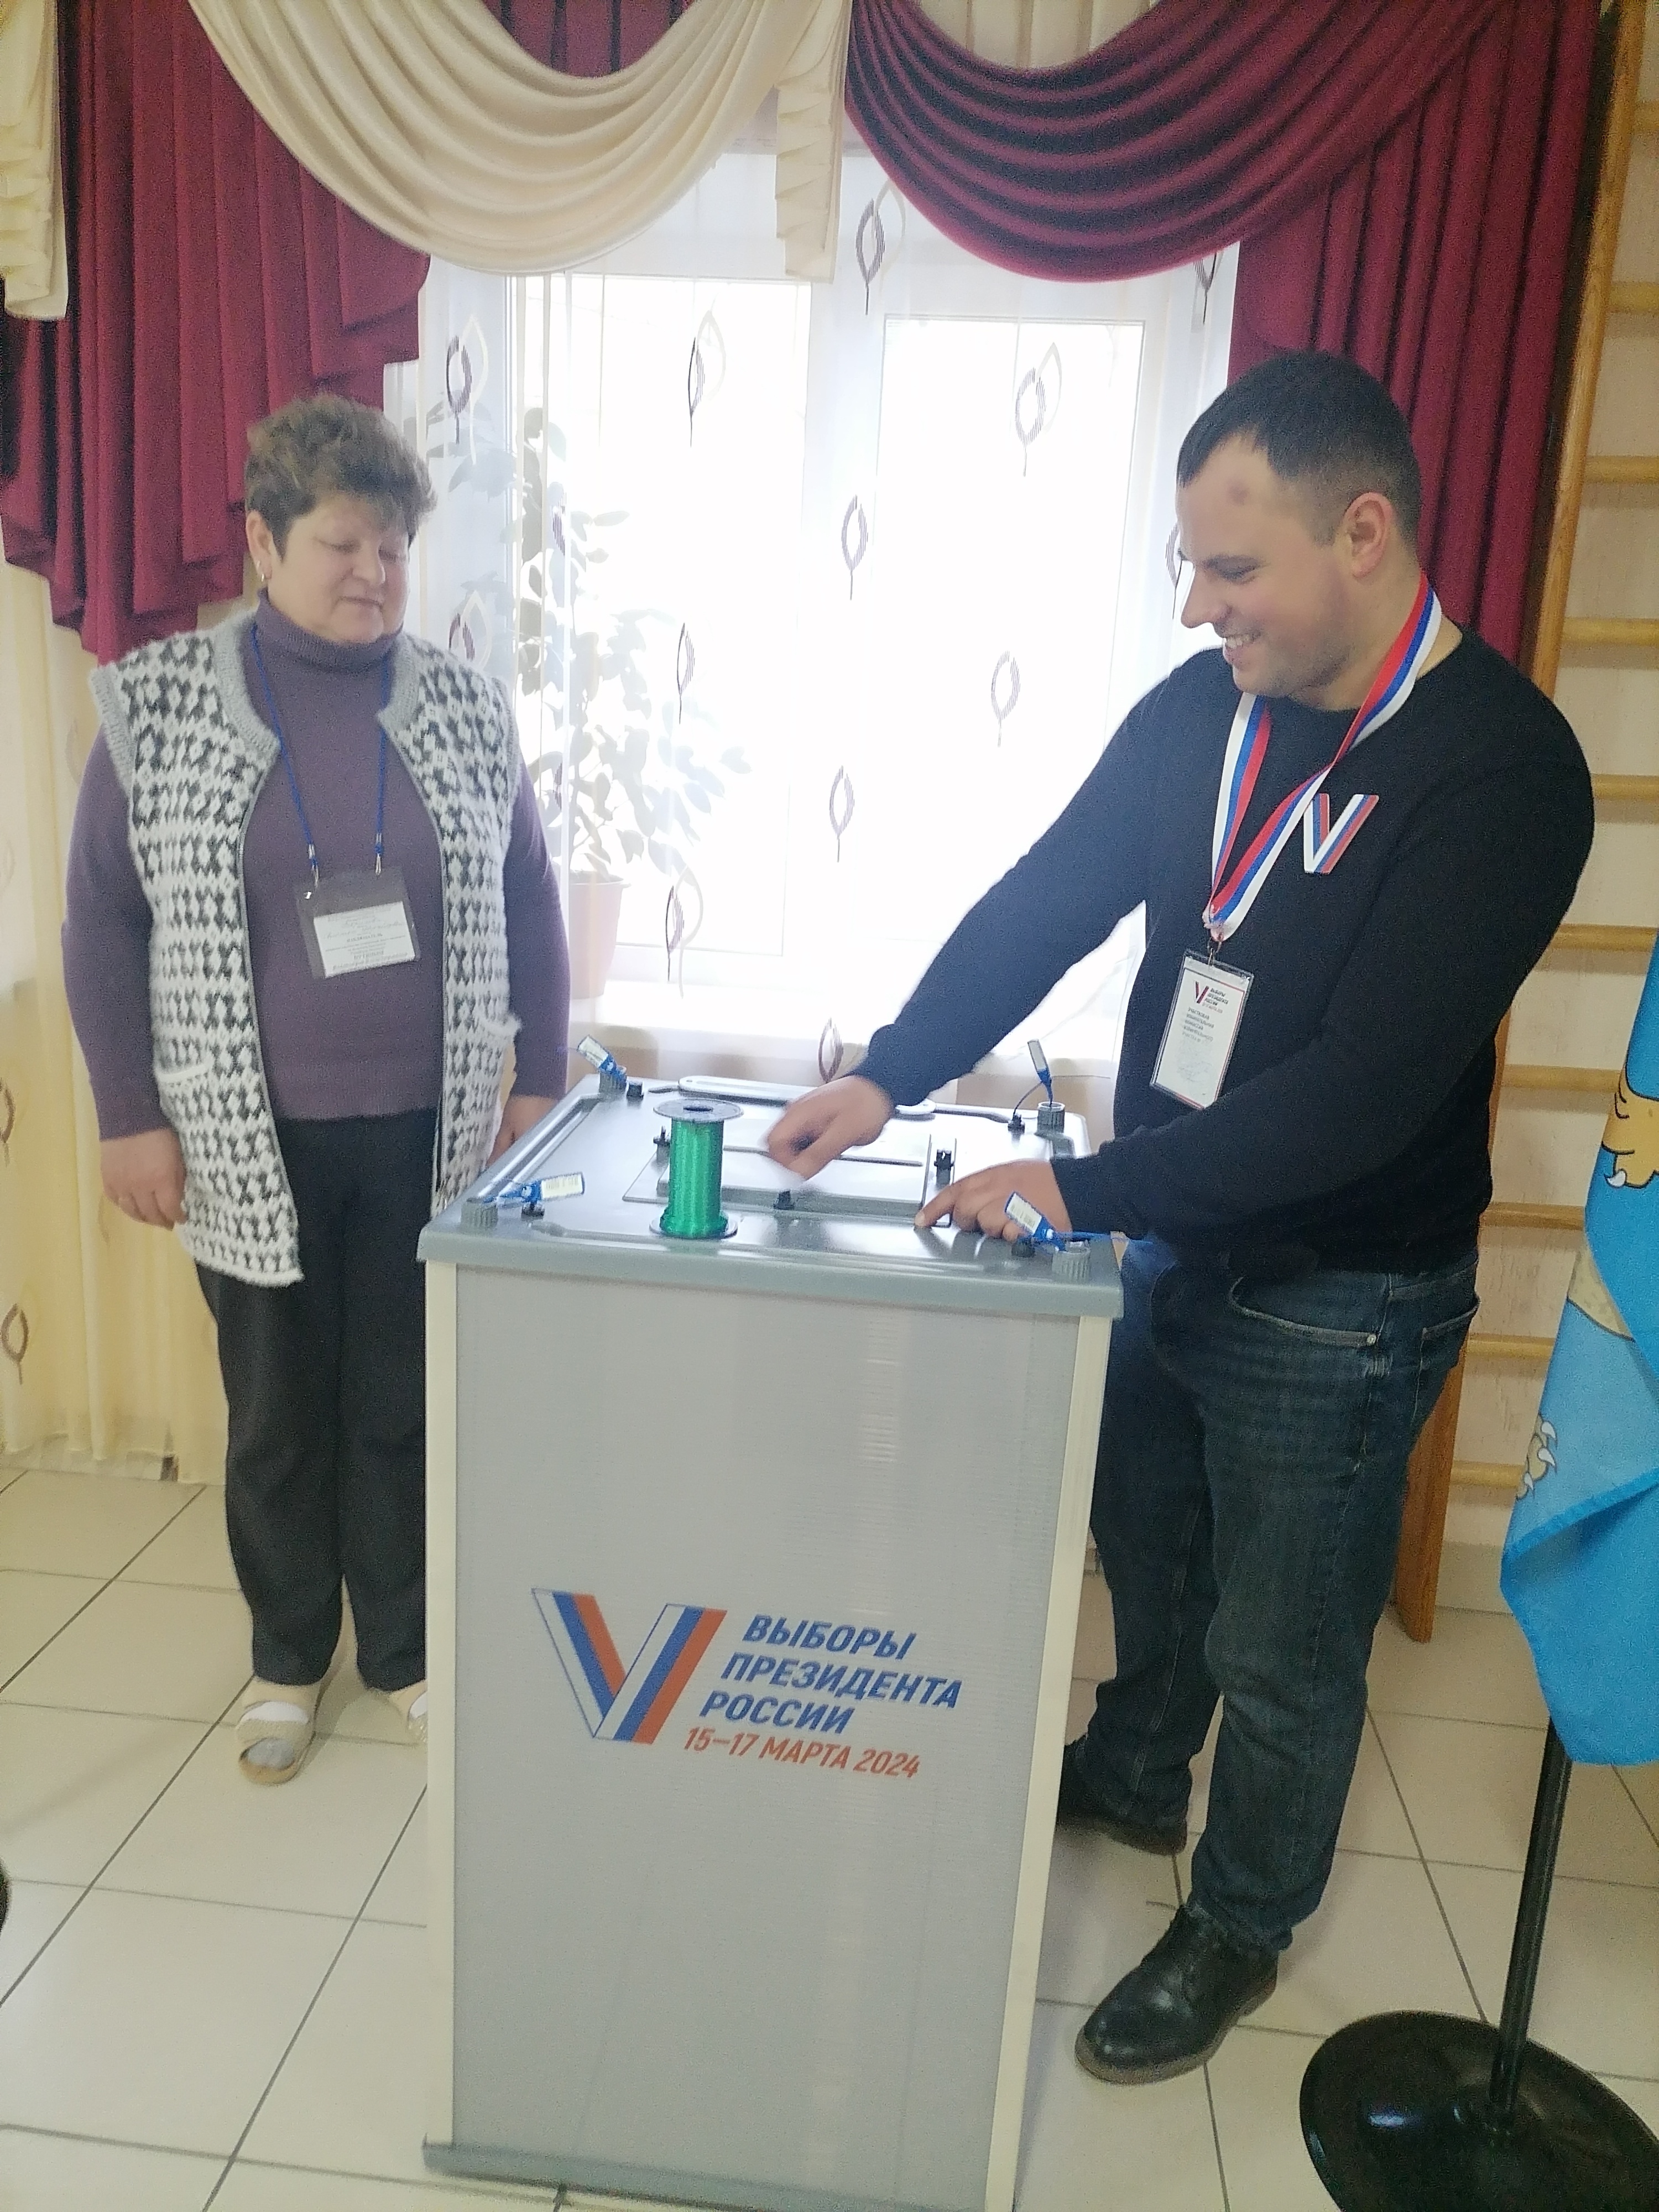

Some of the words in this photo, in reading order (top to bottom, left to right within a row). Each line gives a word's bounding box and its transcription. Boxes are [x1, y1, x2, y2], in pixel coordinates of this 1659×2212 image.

[742, 1614, 917, 1661] ВЫБОРЫ
[721, 1652, 963, 1709] ПРЕЗИДЕНТА
[699, 1690, 854, 1734] РОССИИ
[759, 1736, 852, 1770] МАРТА
[852, 1749, 921, 1778] 2024
